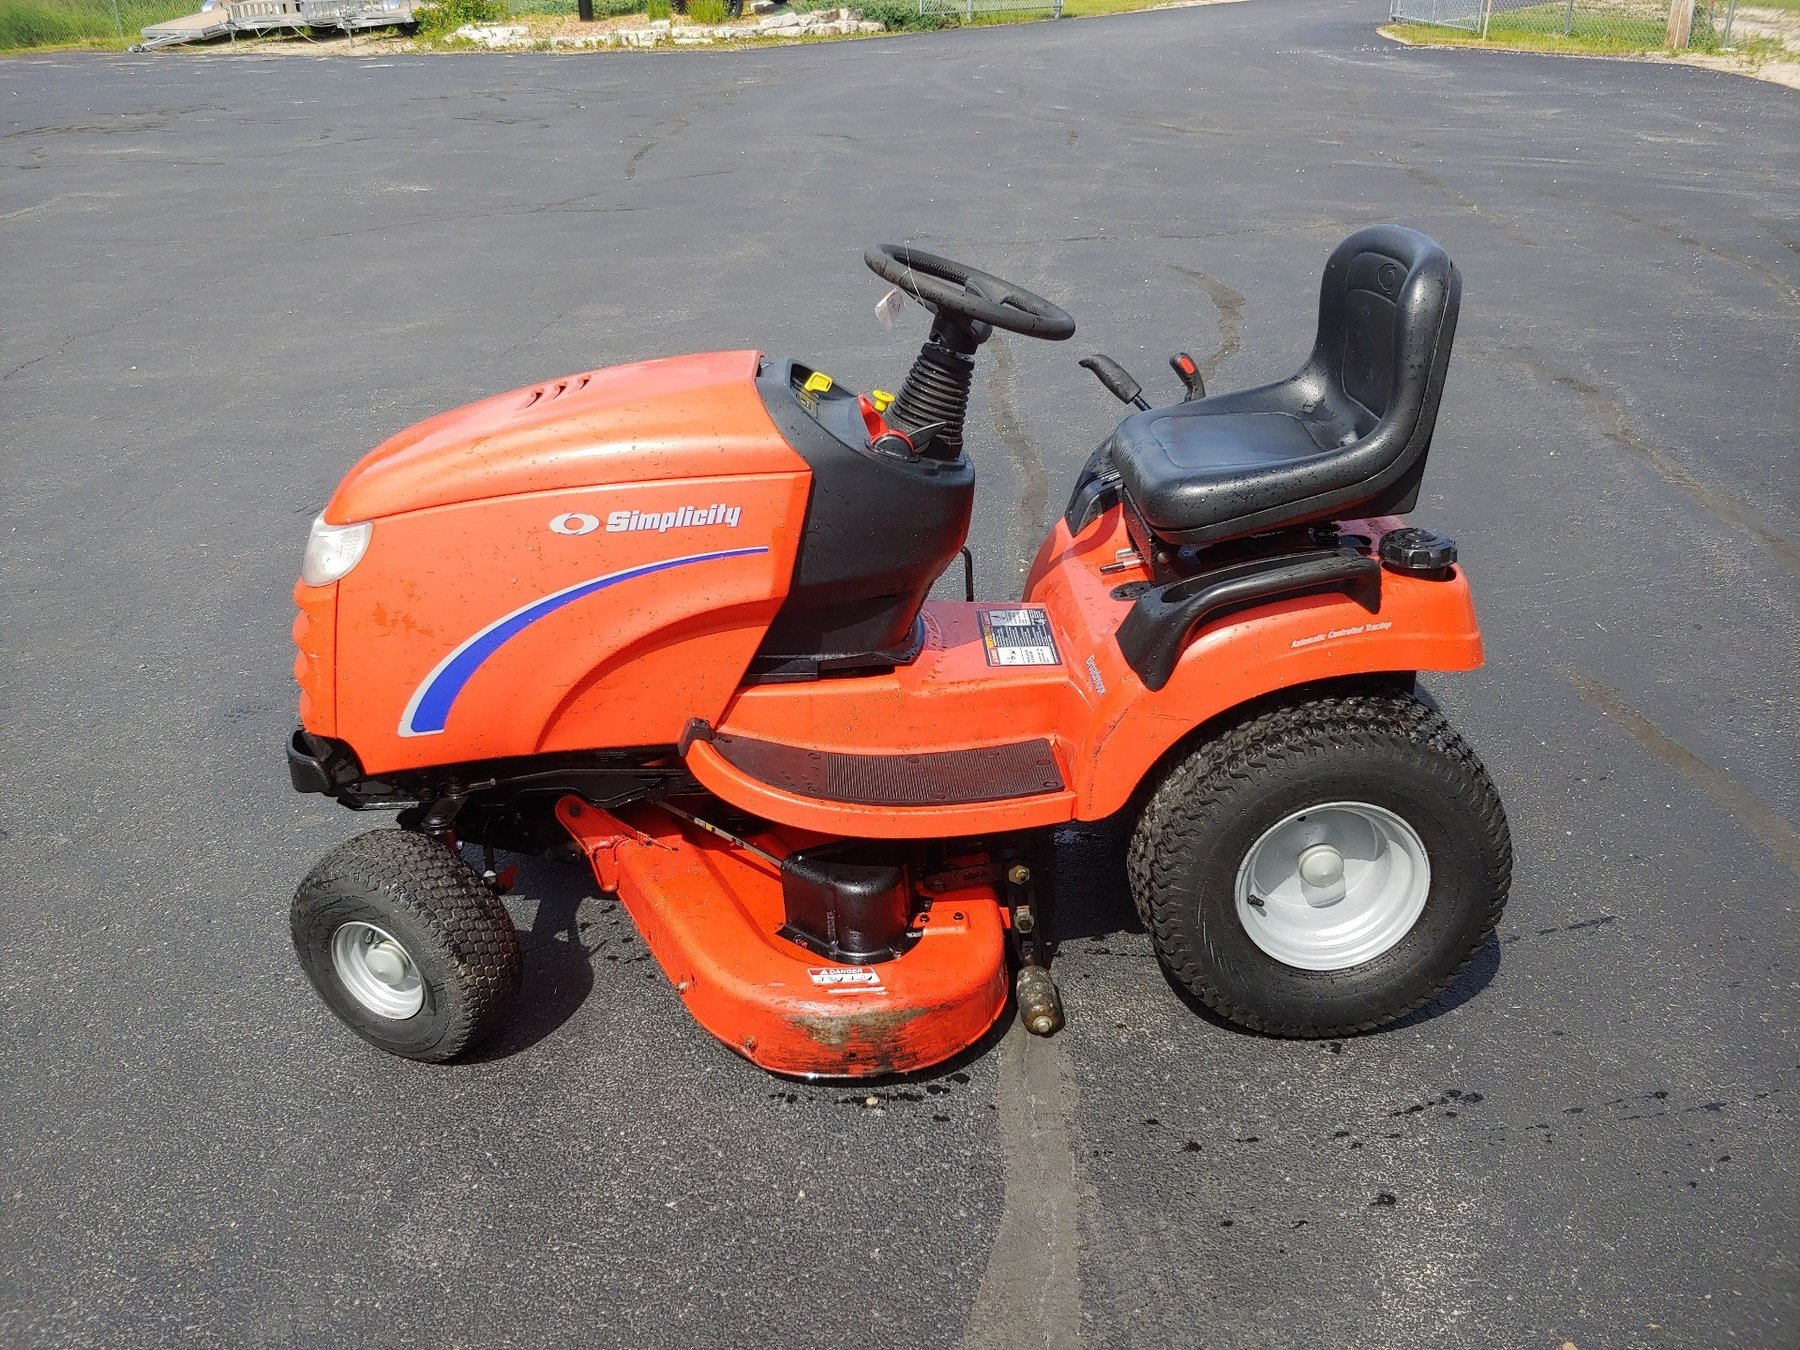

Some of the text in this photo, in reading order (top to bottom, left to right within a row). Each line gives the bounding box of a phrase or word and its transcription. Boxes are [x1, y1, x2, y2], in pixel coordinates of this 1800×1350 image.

[606, 503, 742, 533] Simplicity
[1291, 621, 1392, 648] Automatic Controlled Traction
[1086, 654, 1106, 695] Broadmoor
